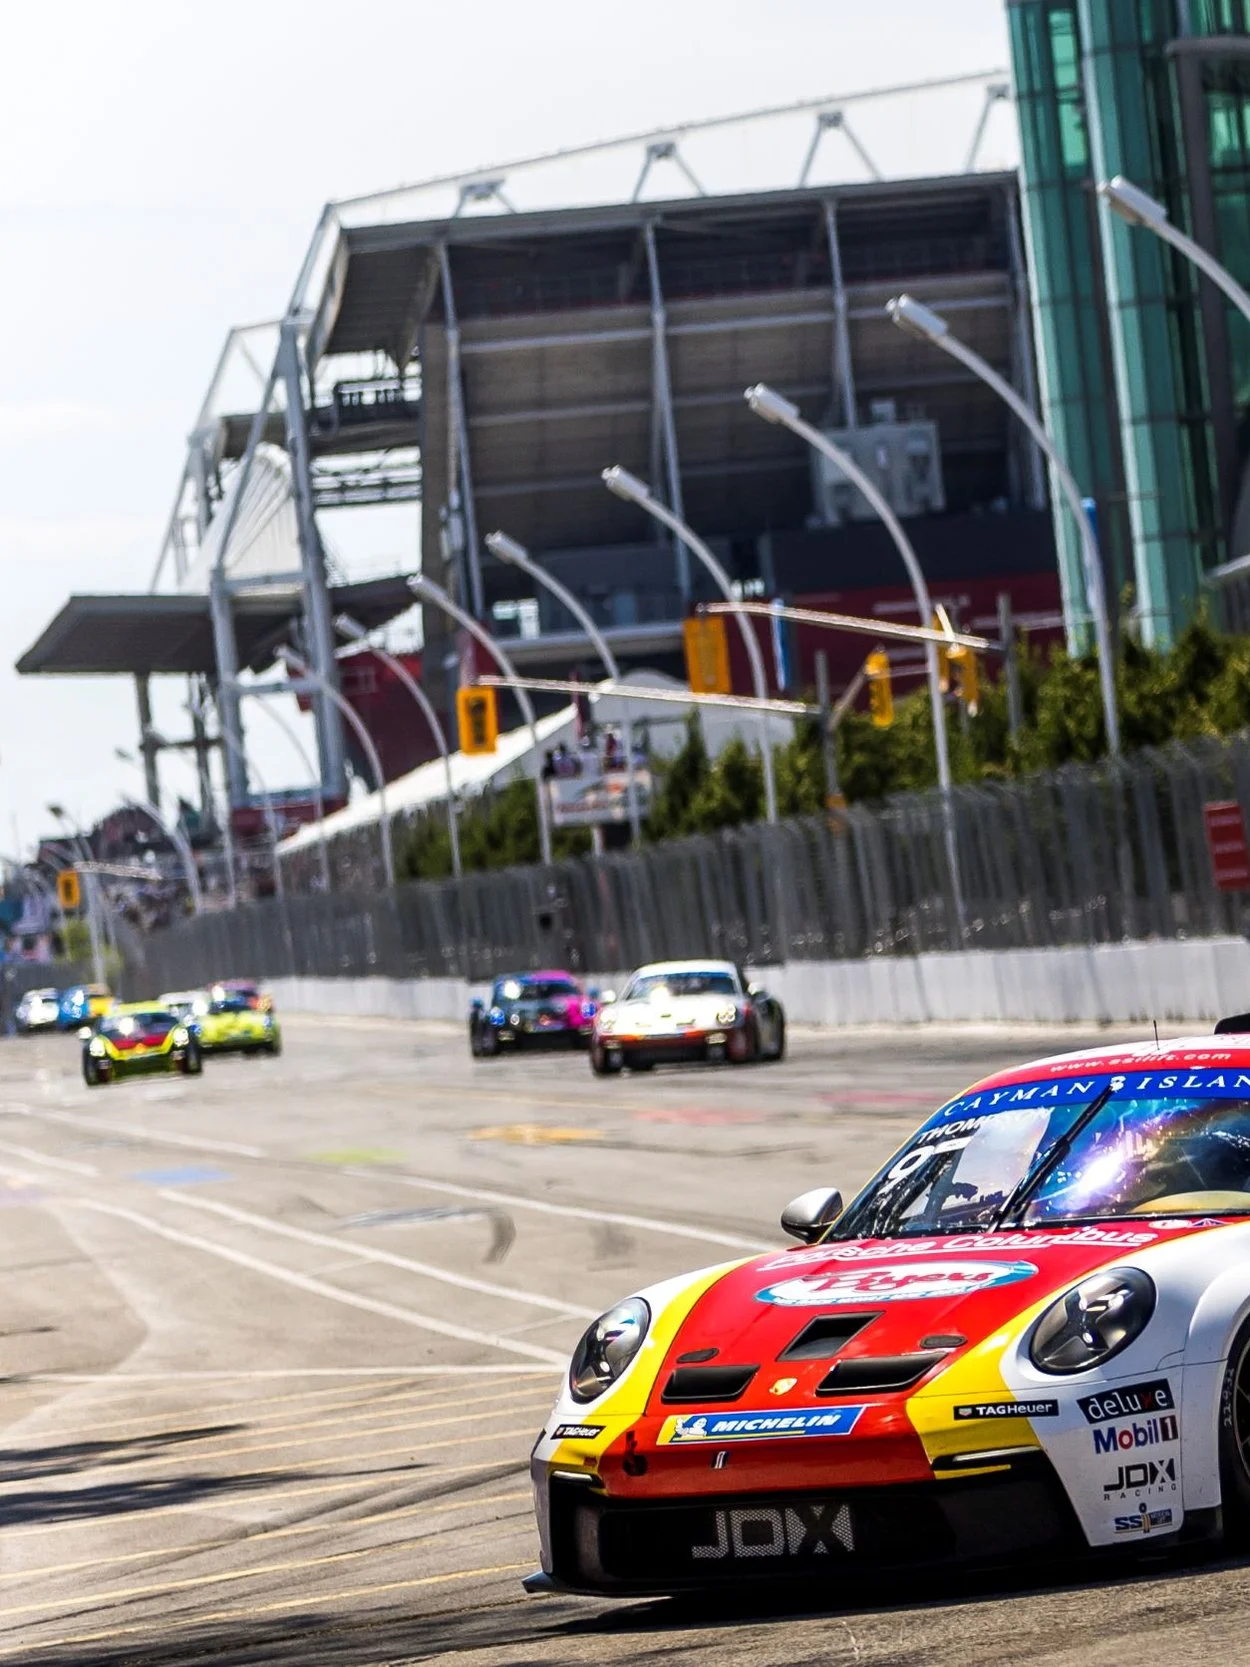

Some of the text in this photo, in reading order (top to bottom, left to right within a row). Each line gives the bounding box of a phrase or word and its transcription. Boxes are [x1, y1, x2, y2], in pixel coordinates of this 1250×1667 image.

[944, 1080, 1096, 1117] CAYMAN
[942, 1226, 1159, 1251] Columbus
[1088, 1389, 1168, 1421] deluxe
[711, 1414, 842, 1433] MICHELIN
[1092, 1418, 1159, 1454] Mobil
[1103, 1458, 1176, 1492] JDX
[1104, 1484, 1177, 1501] RACING
[691, 1503, 856, 1560] JDX
